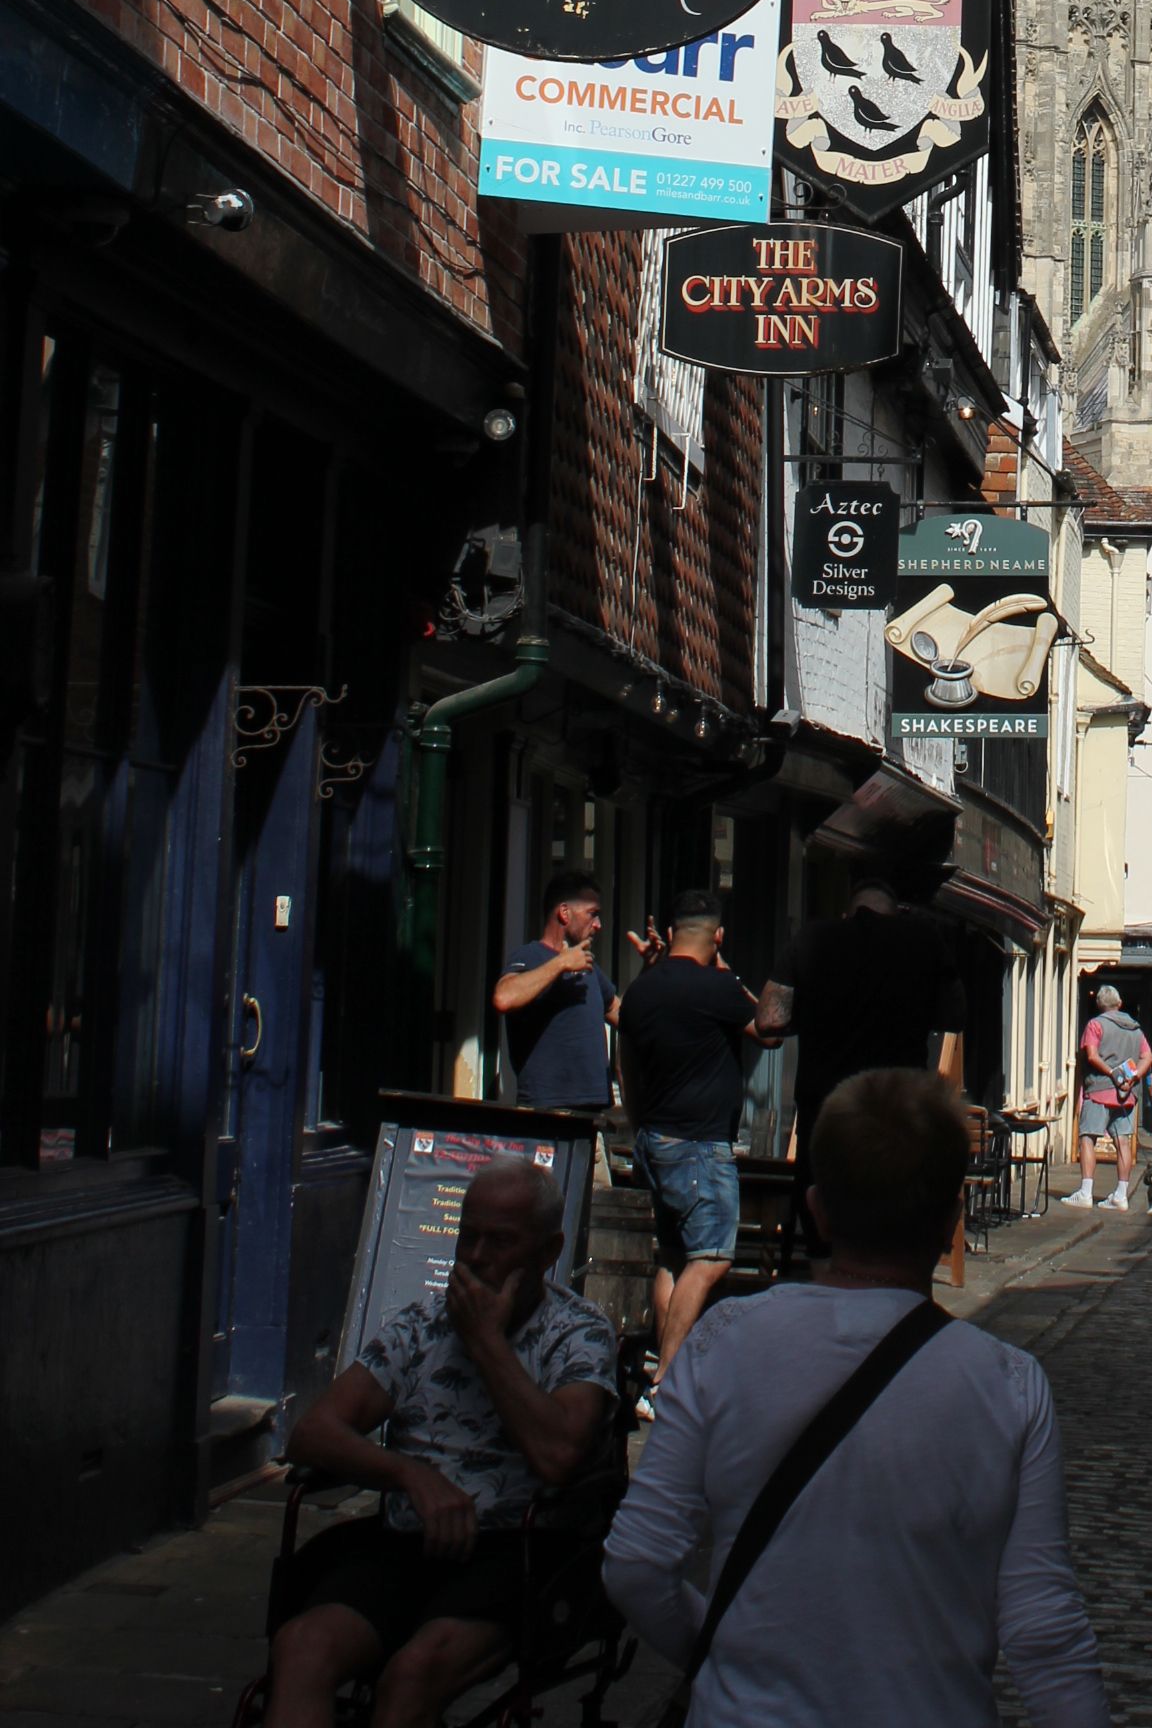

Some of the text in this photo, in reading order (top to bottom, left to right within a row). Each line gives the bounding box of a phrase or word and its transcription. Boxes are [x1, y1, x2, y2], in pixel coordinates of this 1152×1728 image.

[515, 75, 743, 125] COMMERCIAL
[776, 98, 815, 115] AVE
[564, 120, 692, 146] Inc. PearsonGore
[495, 155, 648, 195] FOR SALE
[835, 157, 909, 182] MATER
[656, 172, 752, 194] 01227 499 500
[656, 187, 751, 206] milesandbarr.co.uk
[753, 238, 817, 273] THE
[682, 275, 880, 313] CITY ARMS
[755, 314, 820, 348] INN
[810, 493, 883, 515] Aztec
[822, 563, 868, 579] Silver
[898, 559, 1046, 570] SHEPHERD NEAME
[812, 580, 875, 599] Designs
[900, 718, 1038, 733] SHAKESPEARE
